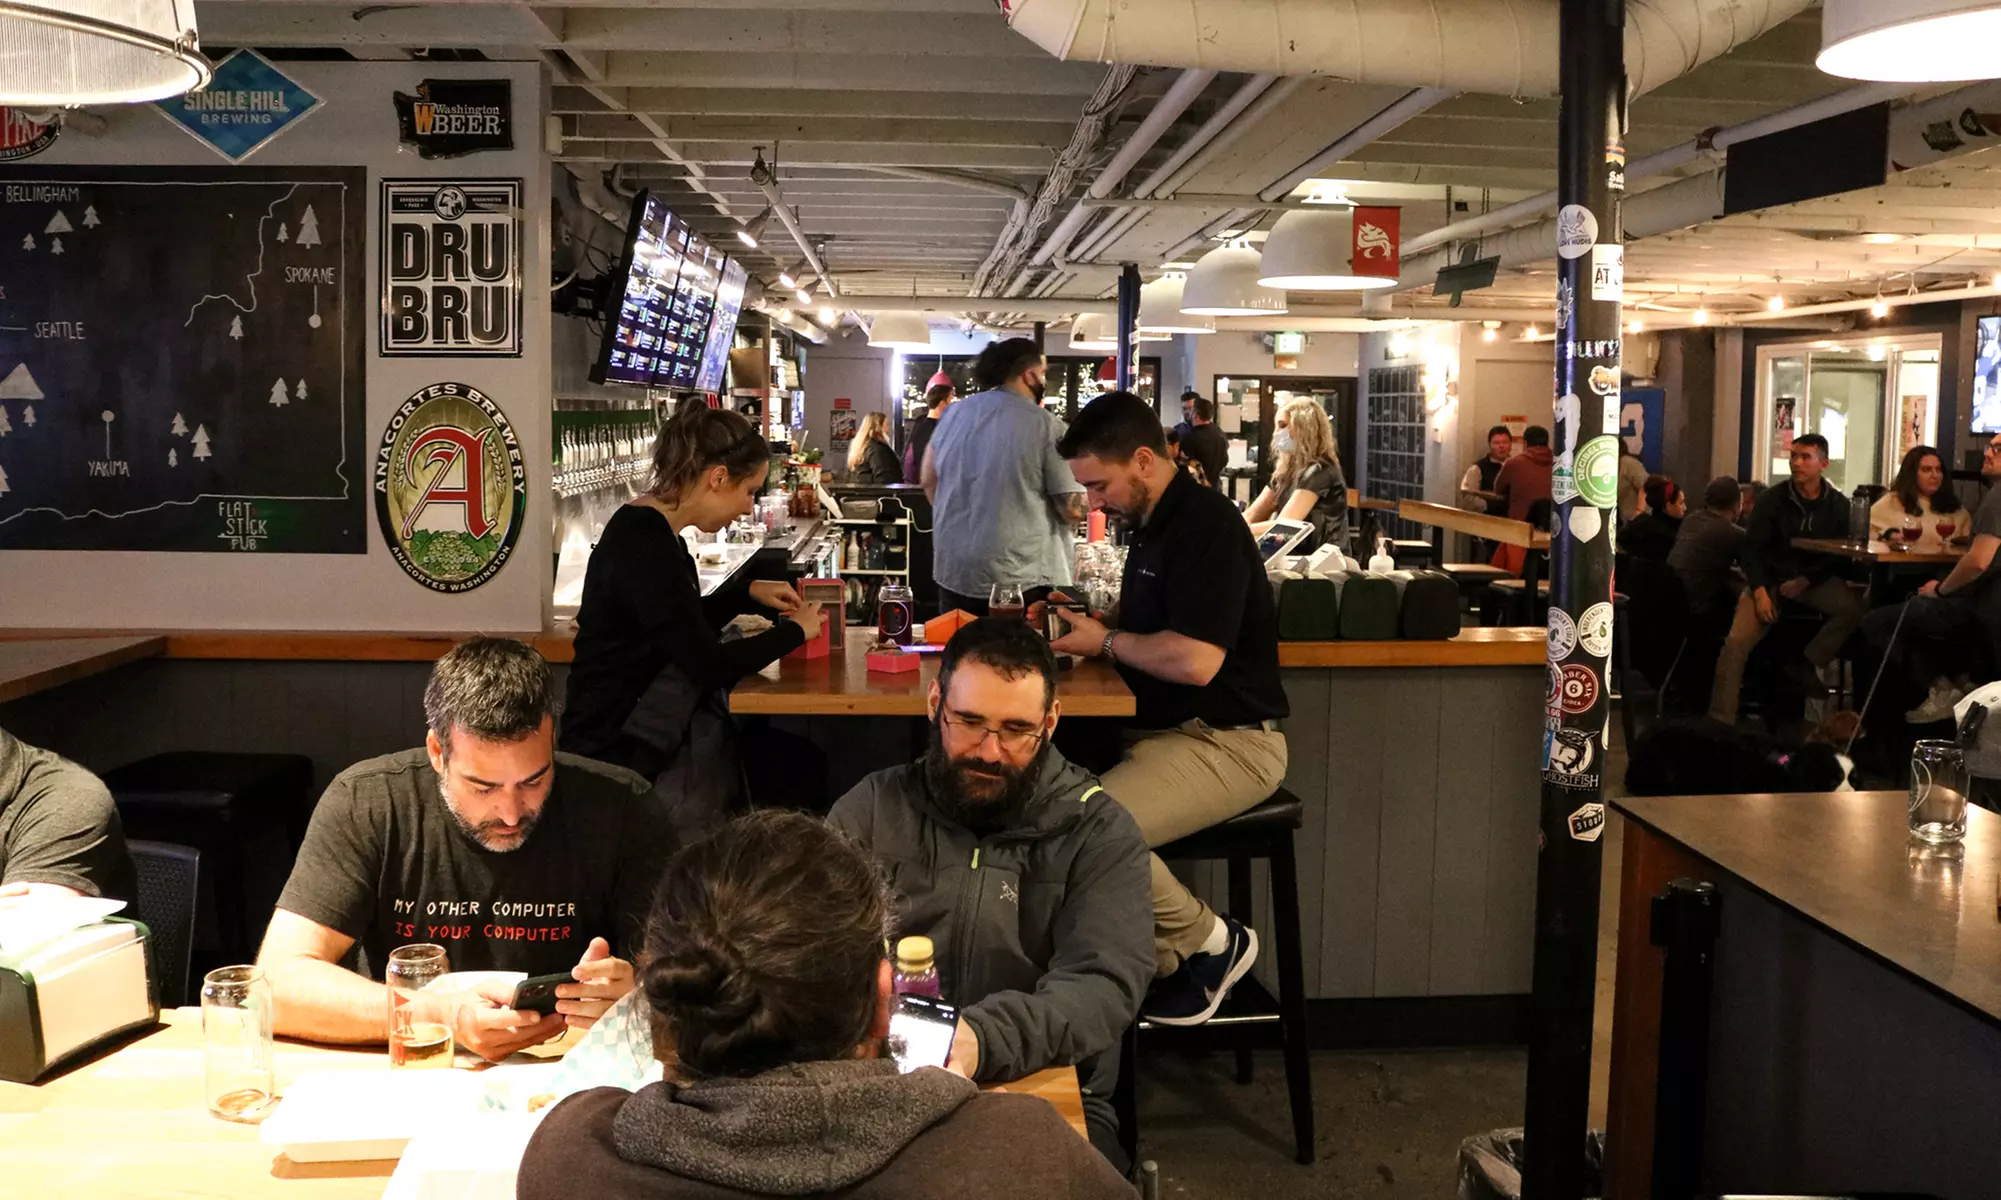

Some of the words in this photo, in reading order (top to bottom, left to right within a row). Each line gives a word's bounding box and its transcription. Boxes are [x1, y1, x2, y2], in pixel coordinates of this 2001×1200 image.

[184, 90, 247, 111] SINGLE
[249, 90, 289, 112] HILL
[435, 103, 500, 118] Washington
[201, 113, 272, 124] BREWING
[433, 114, 502, 135] BEER
[6, 185, 80, 203] BELLINGHAM
[392, 223, 509, 281] DRU
[285, 266, 336, 285] SPOKANE
[392, 286, 509, 344] BRU
[34, 321, 87, 340] SEATTLE
[376, 384, 458, 493] ANACORTES
[466, 388, 525, 494] BREWERY
[88, 460, 131, 478] YAKIMA
[226, 517, 268, 535] STICK
[231, 536, 257, 550] PUB
[391, 546, 446, 591] ANACORTES
[449, 545, 511, 592] WASHINGTON
[1569, 683, 1579, 694] 6
[1584, 682, 1592, 698] SIX
[394, 899, 414, 914] MY
[426, 901, 480, 916] OTHER
[491, 901, 576, 918] COMPUTER
[395, 922, 416, 938] IS
[428, 924, 471, 940] YOUR
[483, 923, 572, 941] COMPUTER
